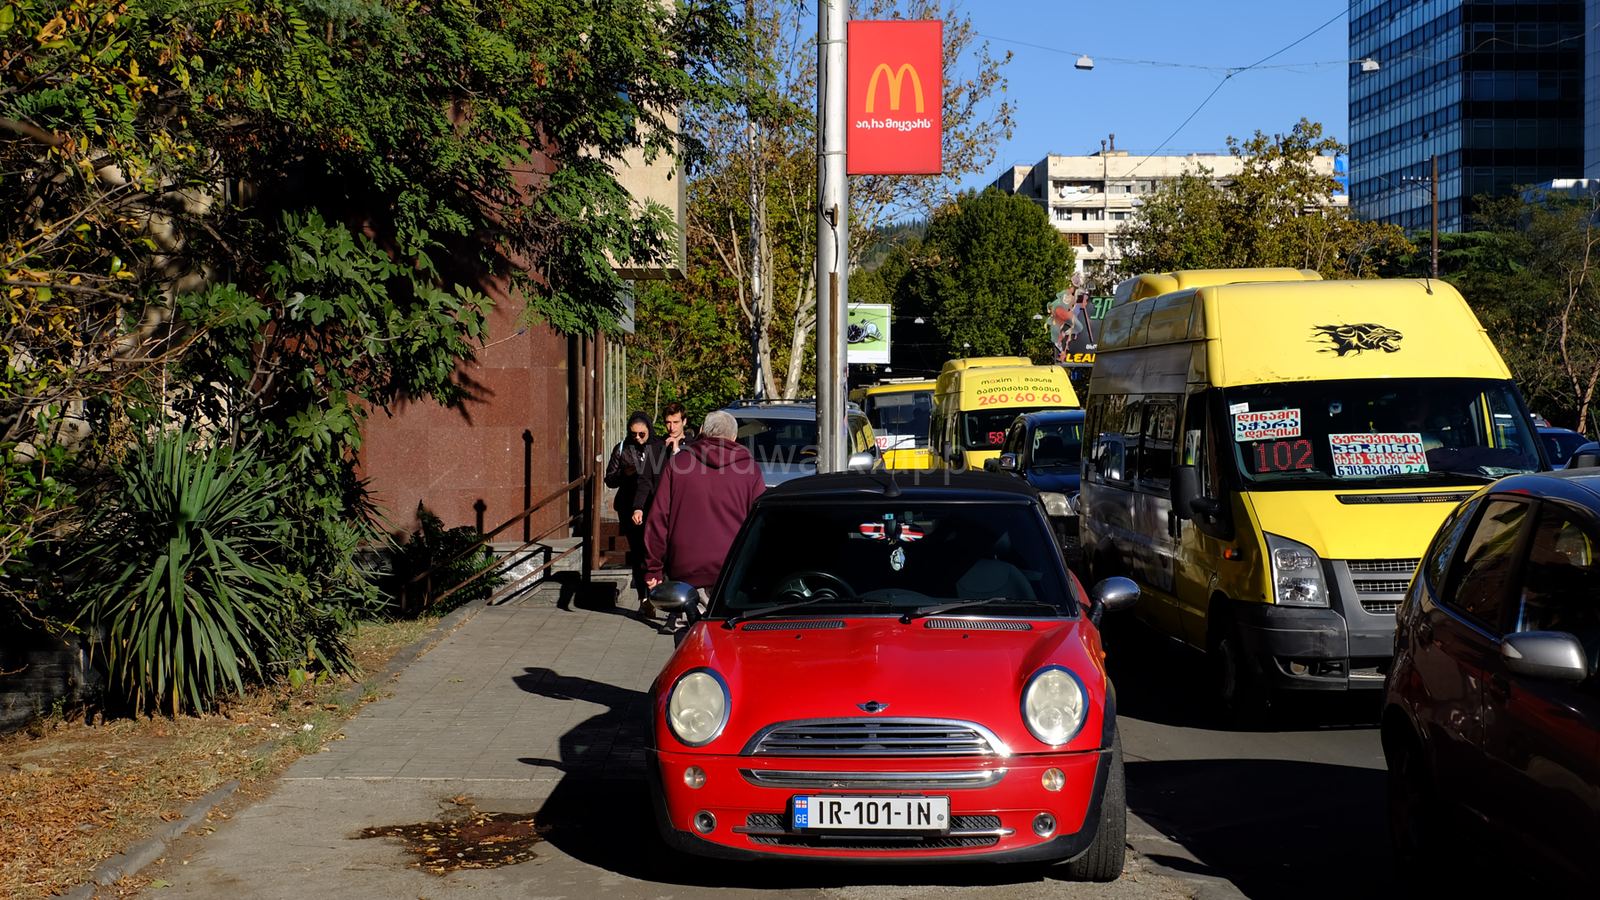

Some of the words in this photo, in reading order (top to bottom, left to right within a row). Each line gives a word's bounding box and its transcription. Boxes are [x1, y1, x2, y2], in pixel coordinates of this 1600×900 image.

[885, 118, 931, 131] მიყვარს
[981, 377, 1012, 385] maxim
[1237, 410, 1299, 422] დინამო
[1237, 418, 1299, 431] აჭარა
[988, 431, 1005, 444] 58
[1244, 427, 1299, 438] დელისი
[1332, 434, 1419, 444] ტელევიზია
[1333, 444, 1422, 453] პეკინი
[1257, 439, 1313, 472] 102
[1334, 453, 1364, 464] ვაჟა
[1367, 452, 1425, 464] ფშაველა
[1337, 464, 1401, 476] ნუცუბიძე
[795, 814, 807, 824] GE
[818, 801, 931, 825] IR-101-IN
